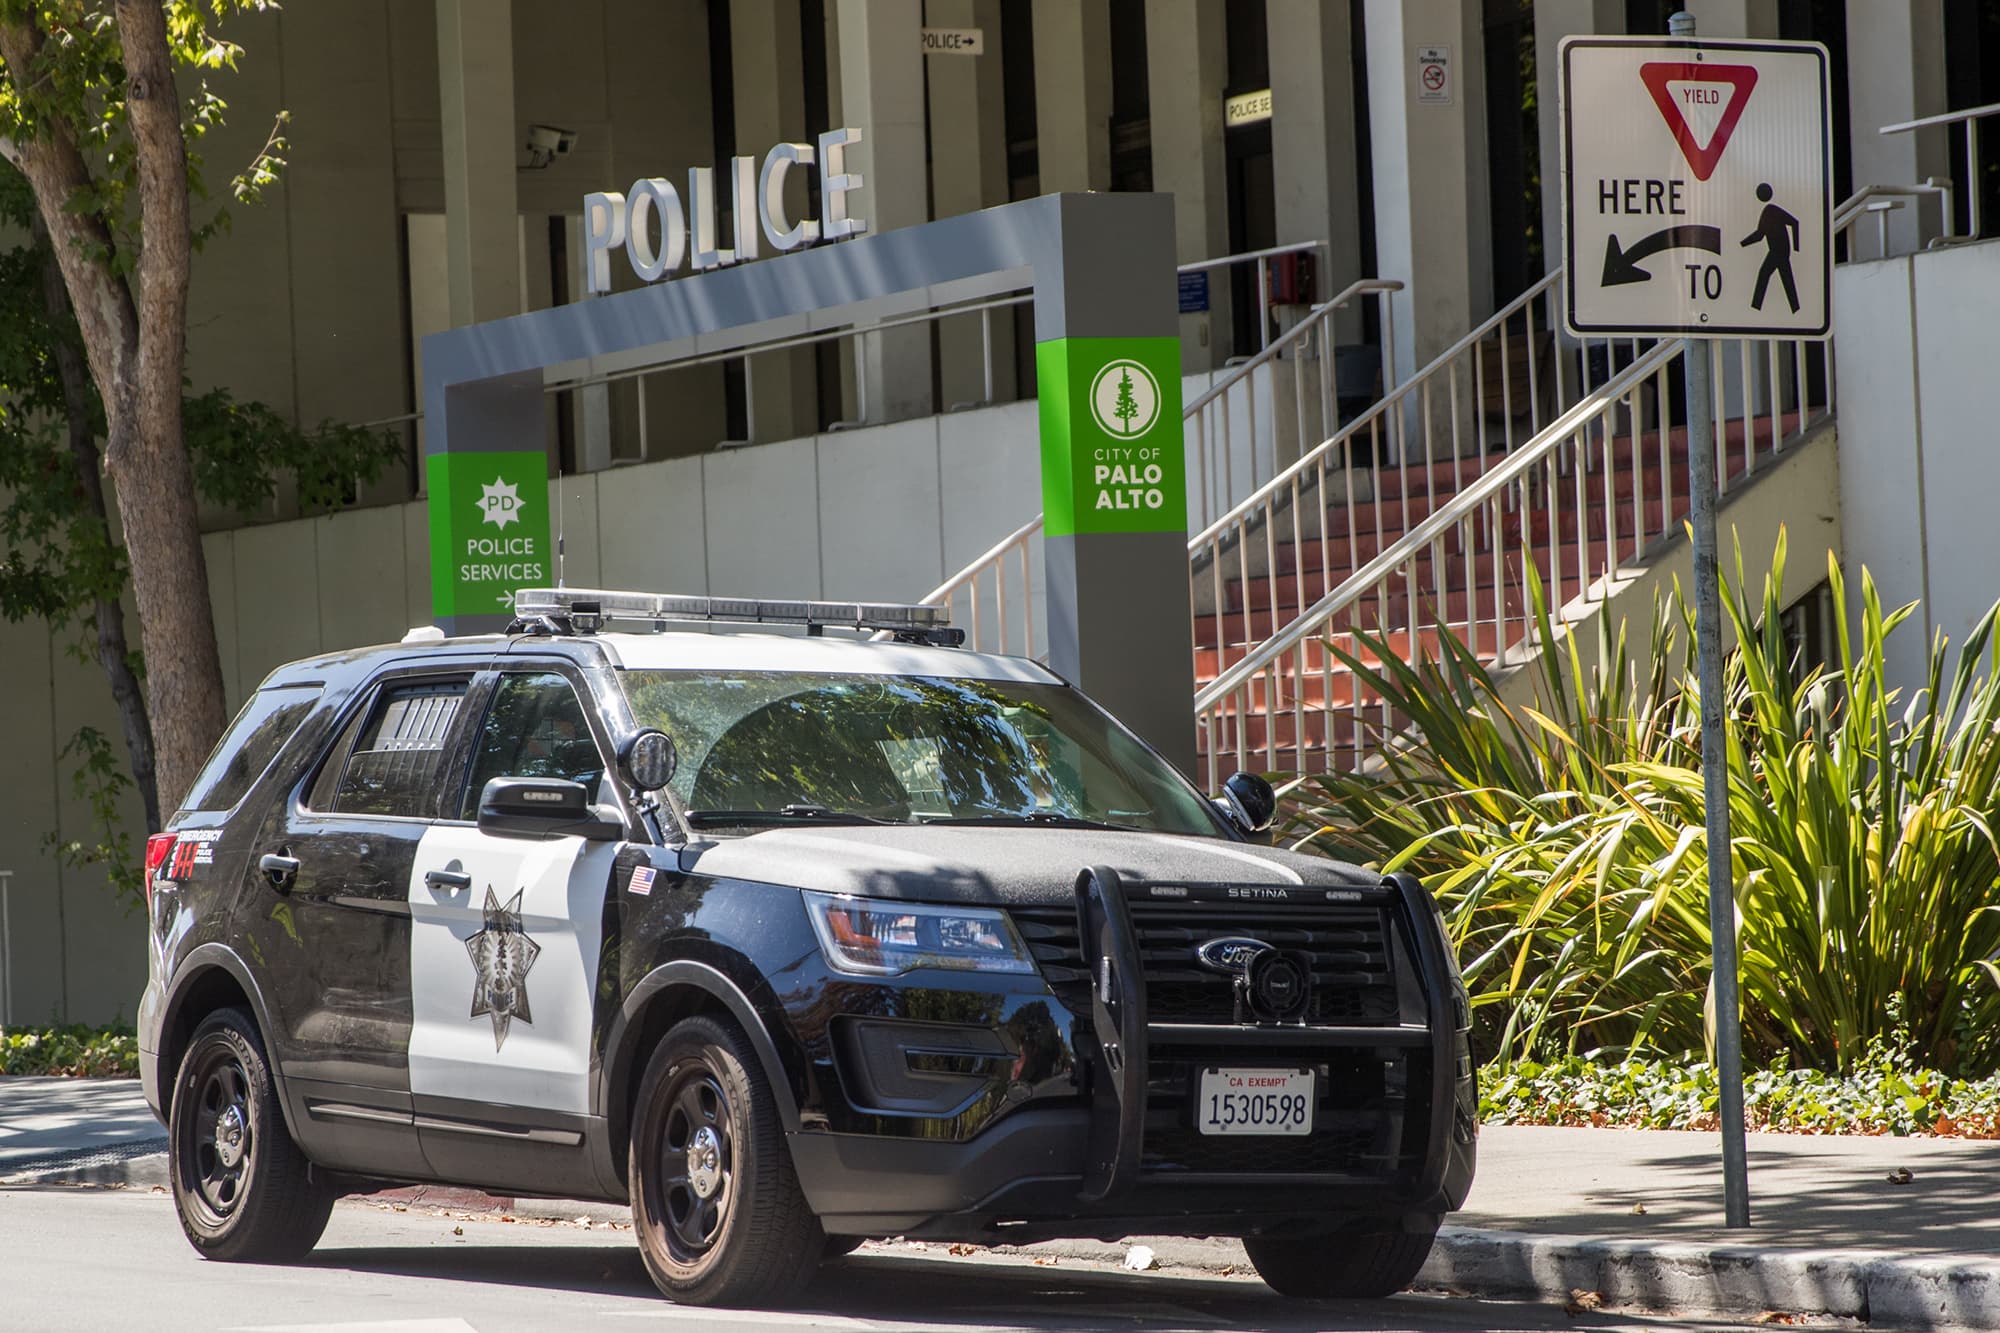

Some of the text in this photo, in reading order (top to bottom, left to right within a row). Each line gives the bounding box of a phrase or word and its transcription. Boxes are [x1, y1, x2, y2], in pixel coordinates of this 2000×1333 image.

[921, 33, 962, 49] POLICE
[1683, 88, 1720, 105] YIELD
[1230, 99, 1258, 119] POLICE
[1599, 179, 1686, 215] HERE
[584, 128, 867, 293] POLICE
[1685, 264, 1722, 300] TO
[1094, 447, 1161, 461] CITY OF
[1094, 464, 1163, 485] PALO
[487, 495, 515, 512] PD
[1095, 488, 1164, 510] ALTO
[467, 538, 535, 556] POLICE
[460, 563, 543, 581] SERVICES
[177, 829, 224, 842] EMERGENCY
[1228, 887, 1289, 899] SETINA
[1221, 943, 1259, 963] For
[1229, 1078, 1288, 1088] CA EXEMPT
[1208, 1094, 1307, 1125] 1530598
